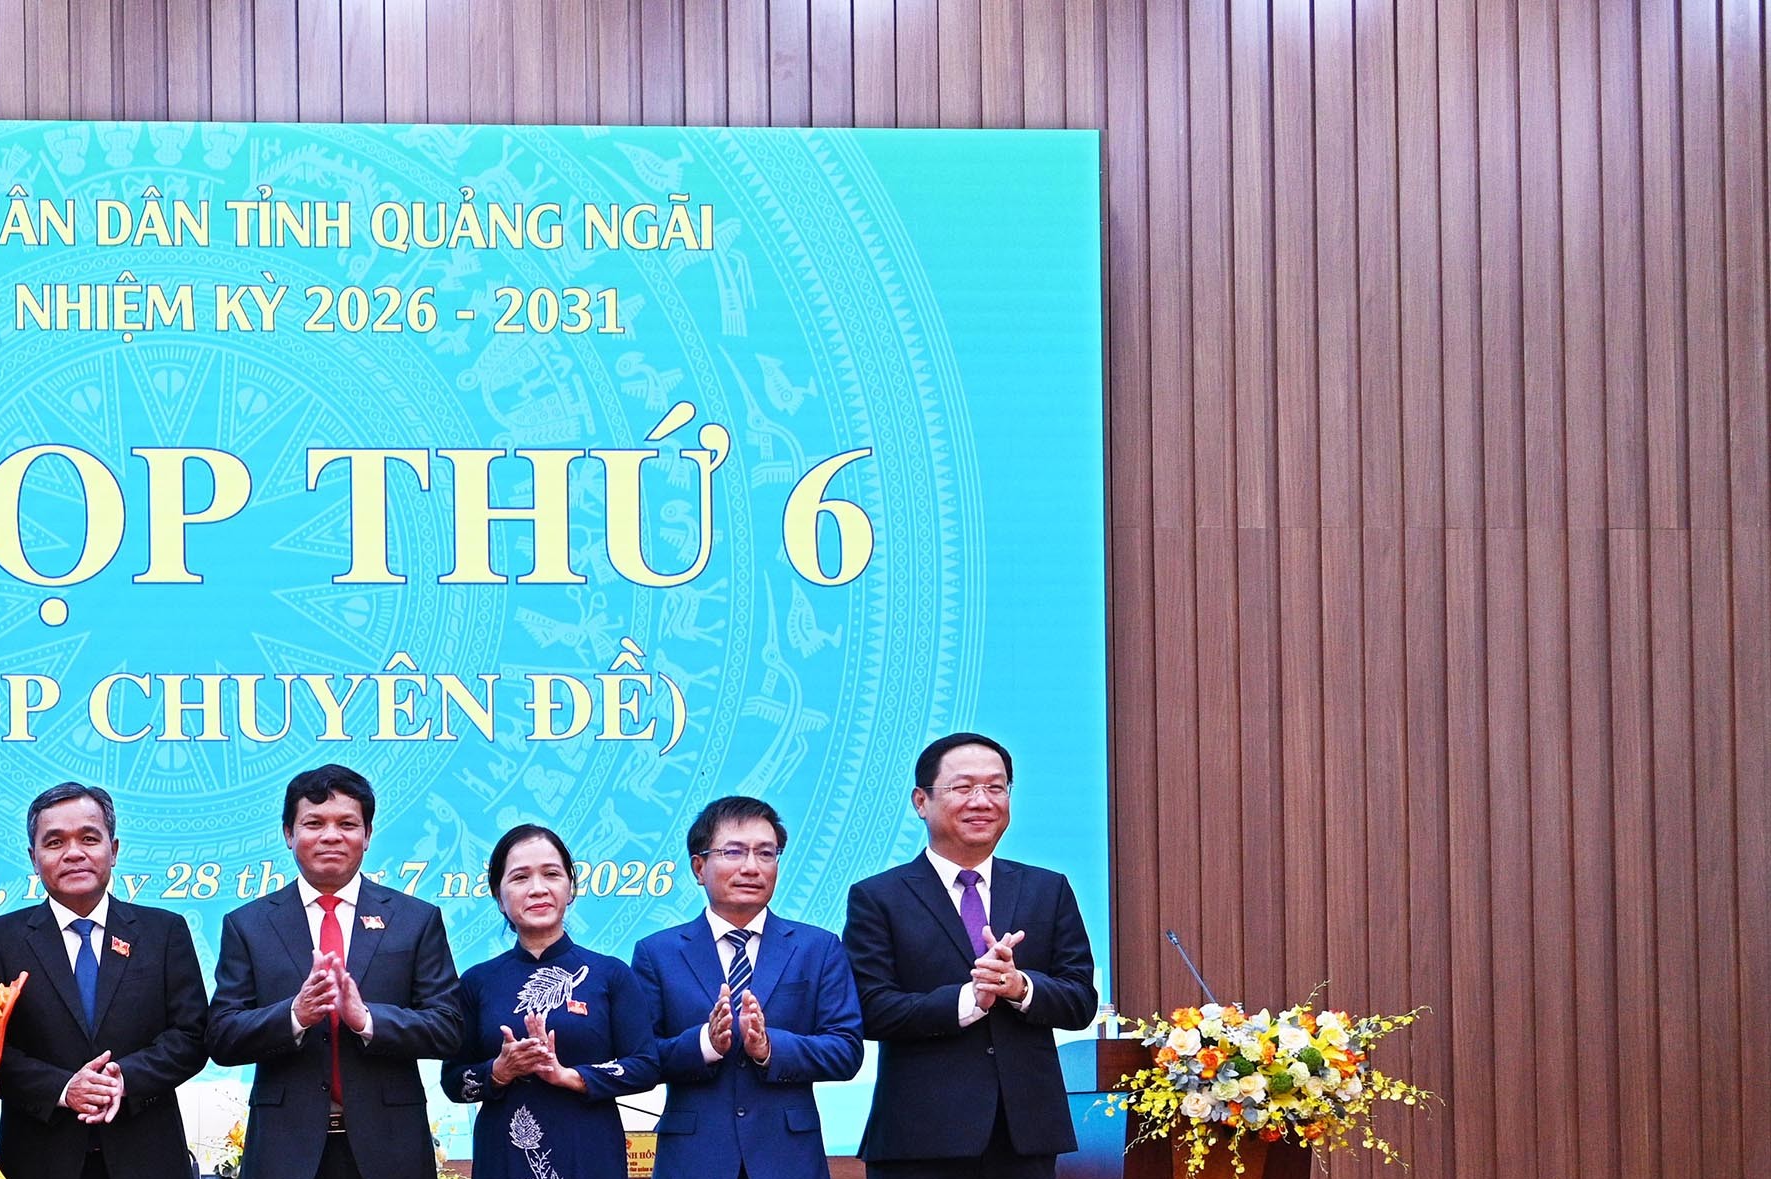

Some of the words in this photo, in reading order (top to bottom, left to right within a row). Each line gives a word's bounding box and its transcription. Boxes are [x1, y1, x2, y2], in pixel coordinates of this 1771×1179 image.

[96, 185, 210, 248] DÂN
[225, 185, 352, 248] TỈNH
[370, 186, 564, 254] QUẢNG
[584, 192, 714, 251] NGÃI
[15, 271, 195, 343] NHIỆM
[215, 271, 289, 332] KỲ
[303, 285, 437, 333] 2026
[456, 309, 475, 321] -
[494, 286, 625, 334] 2031
[306, 400, 731, 589] THỨ
[782, 446, 875, 588] 6
[88, 650, 501, 744] CHUYÊN
[524, 636, 687, 757] ĐỀ)
[160, 861, 222, 900] 28
[399, 861, 430, 896] 7
[570, 860, 676, 898] 2026
